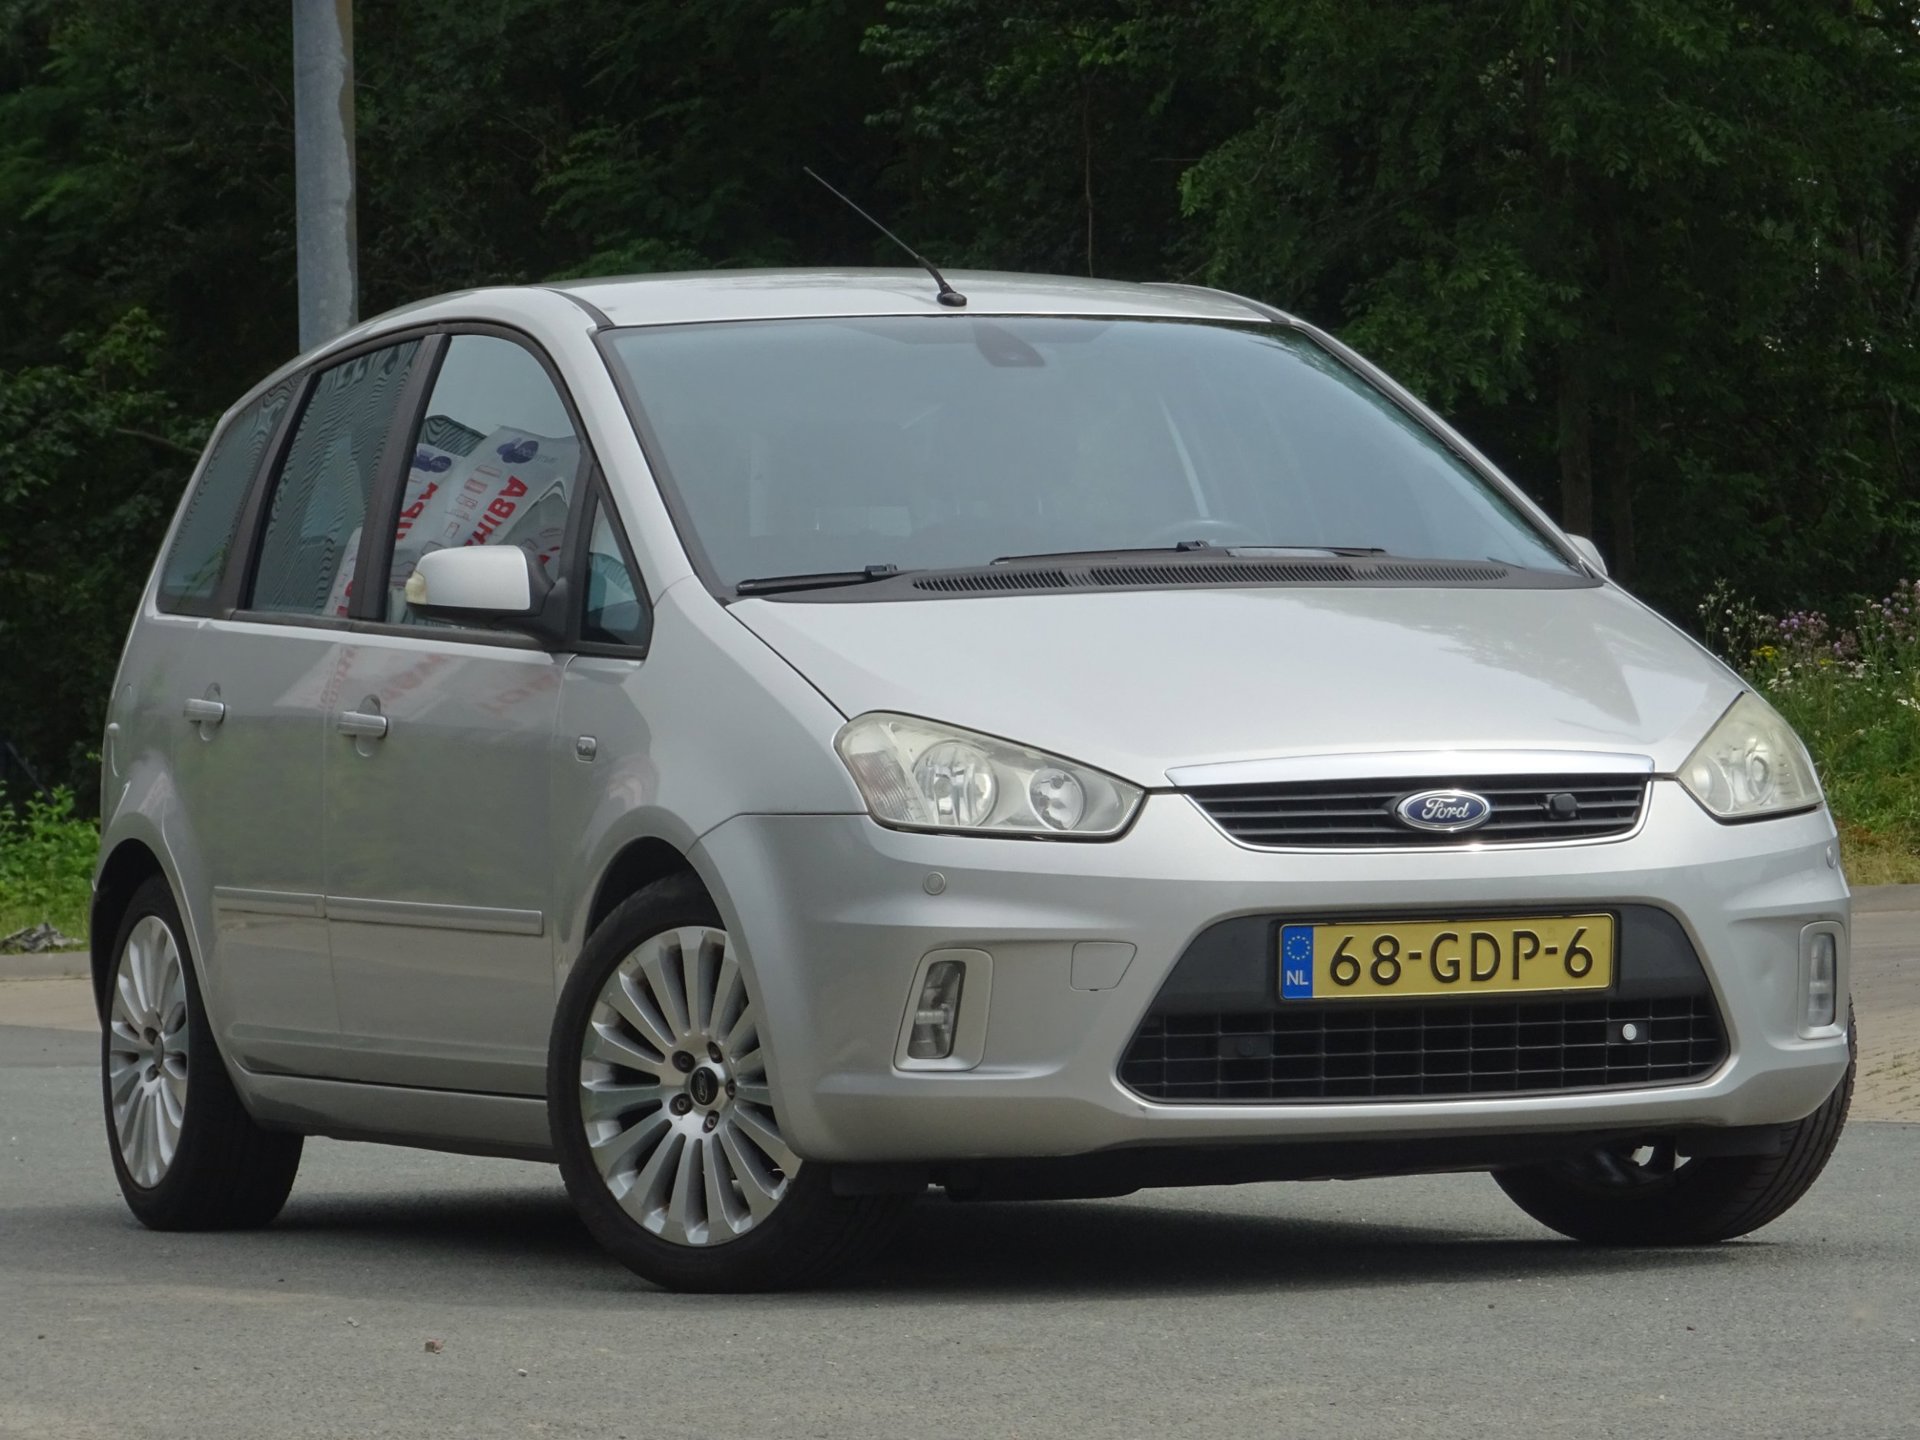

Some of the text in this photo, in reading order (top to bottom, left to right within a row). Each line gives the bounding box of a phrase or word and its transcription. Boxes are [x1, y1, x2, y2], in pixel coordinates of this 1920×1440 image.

[1422, 798, 1469, 820] Ford
[1329, 928, 1594, 987] 68-GDP-6
[1286, 971, 1309, 986] NL
